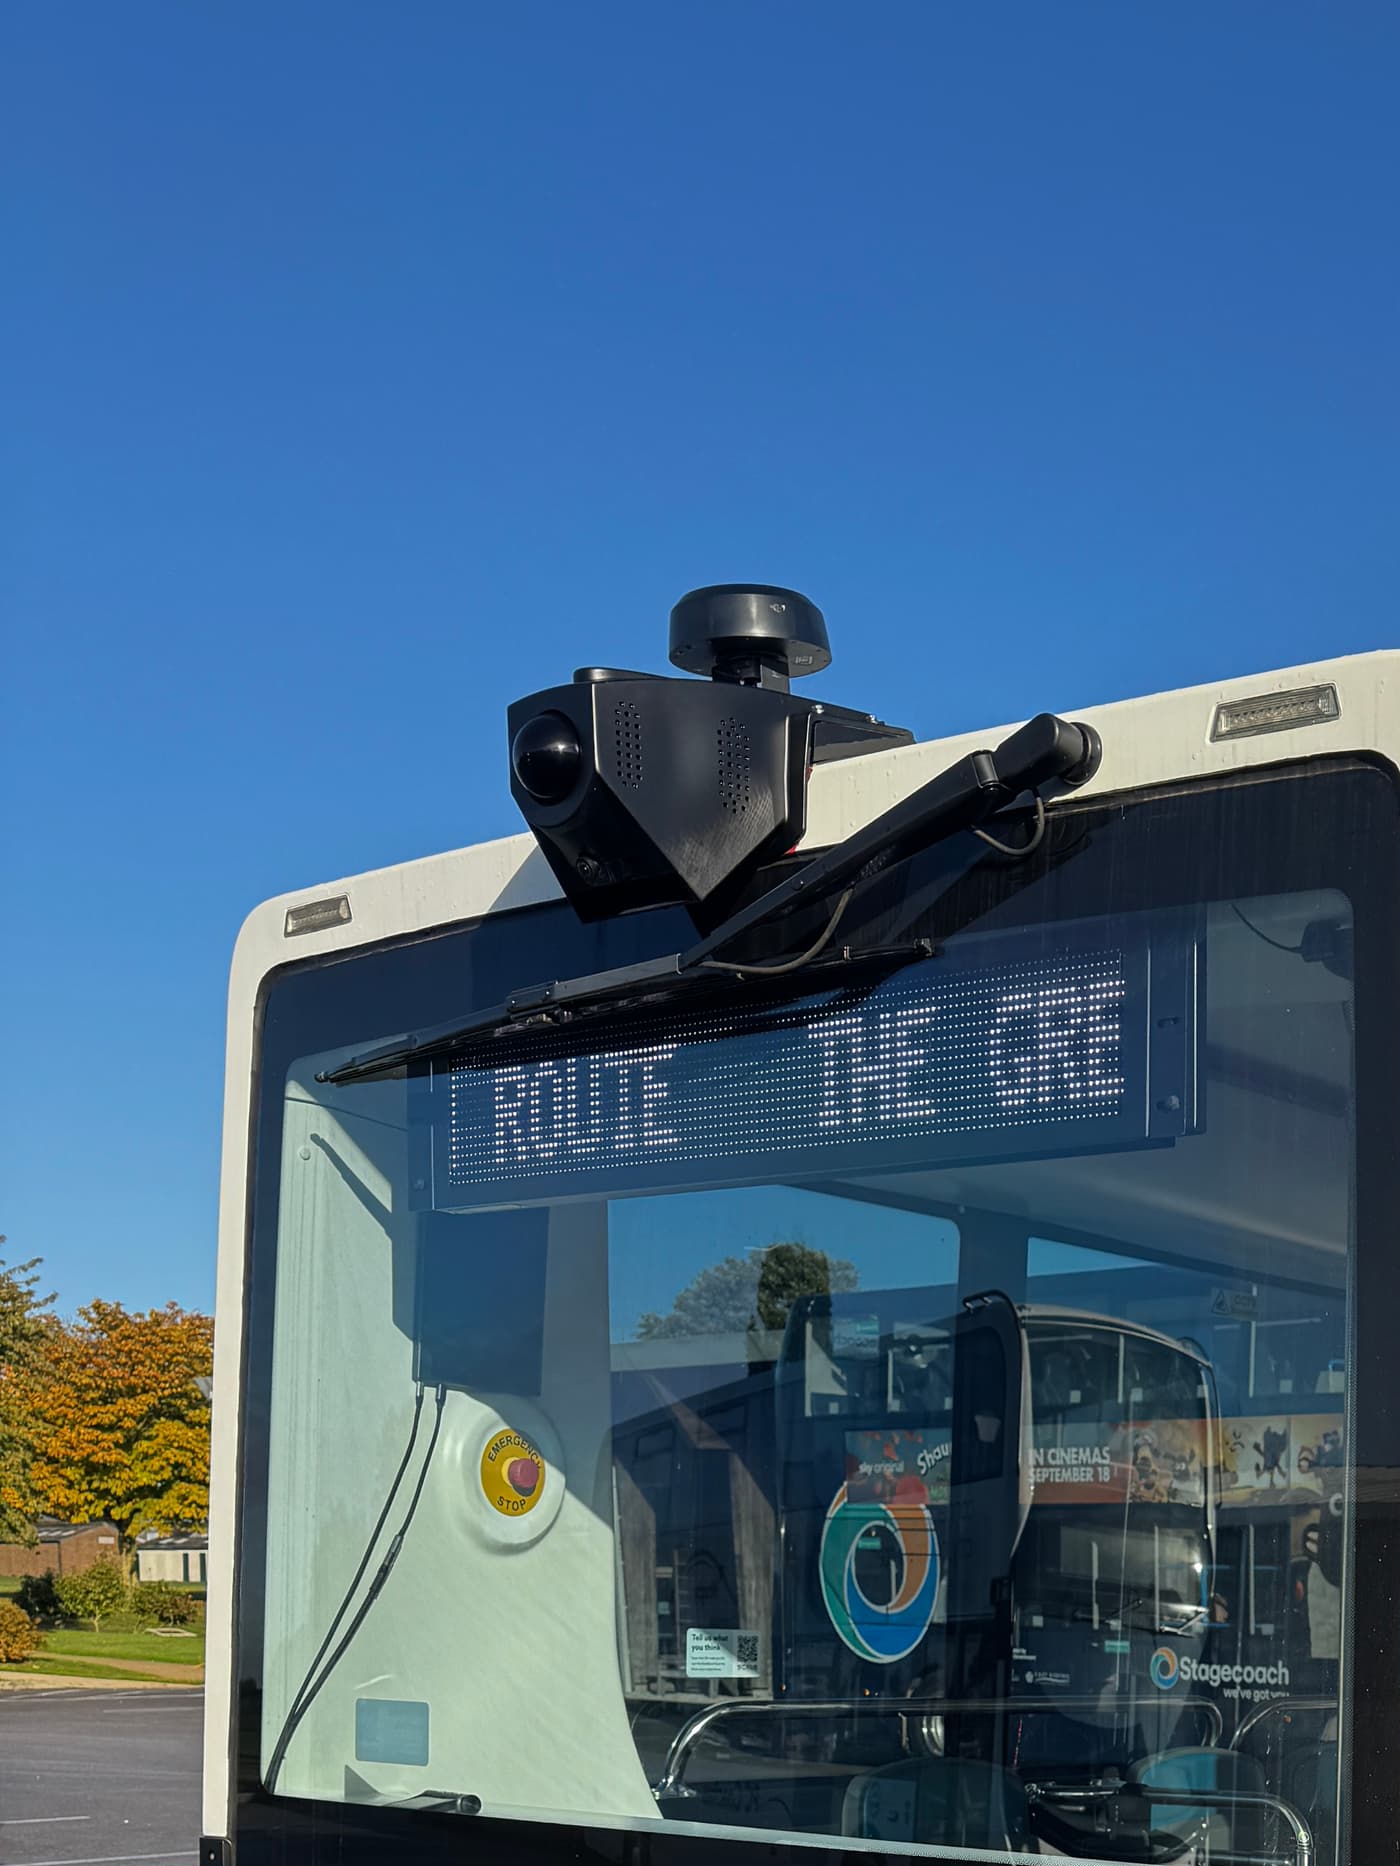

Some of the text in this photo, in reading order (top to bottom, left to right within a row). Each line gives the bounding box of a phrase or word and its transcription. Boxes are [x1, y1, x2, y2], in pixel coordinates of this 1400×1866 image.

[494, 1043, 679, 1163] ROUTE
[807, 1006, 937, 1126] THE
[1047, 1446, 1110, 1465] CINEMAS
[1028, 1466, 1110, 1482] SEPTEMBER 18
[497, 1495, 526, 1511] STOP
[1180, 1656, 1290, 1686] Stagecoach
